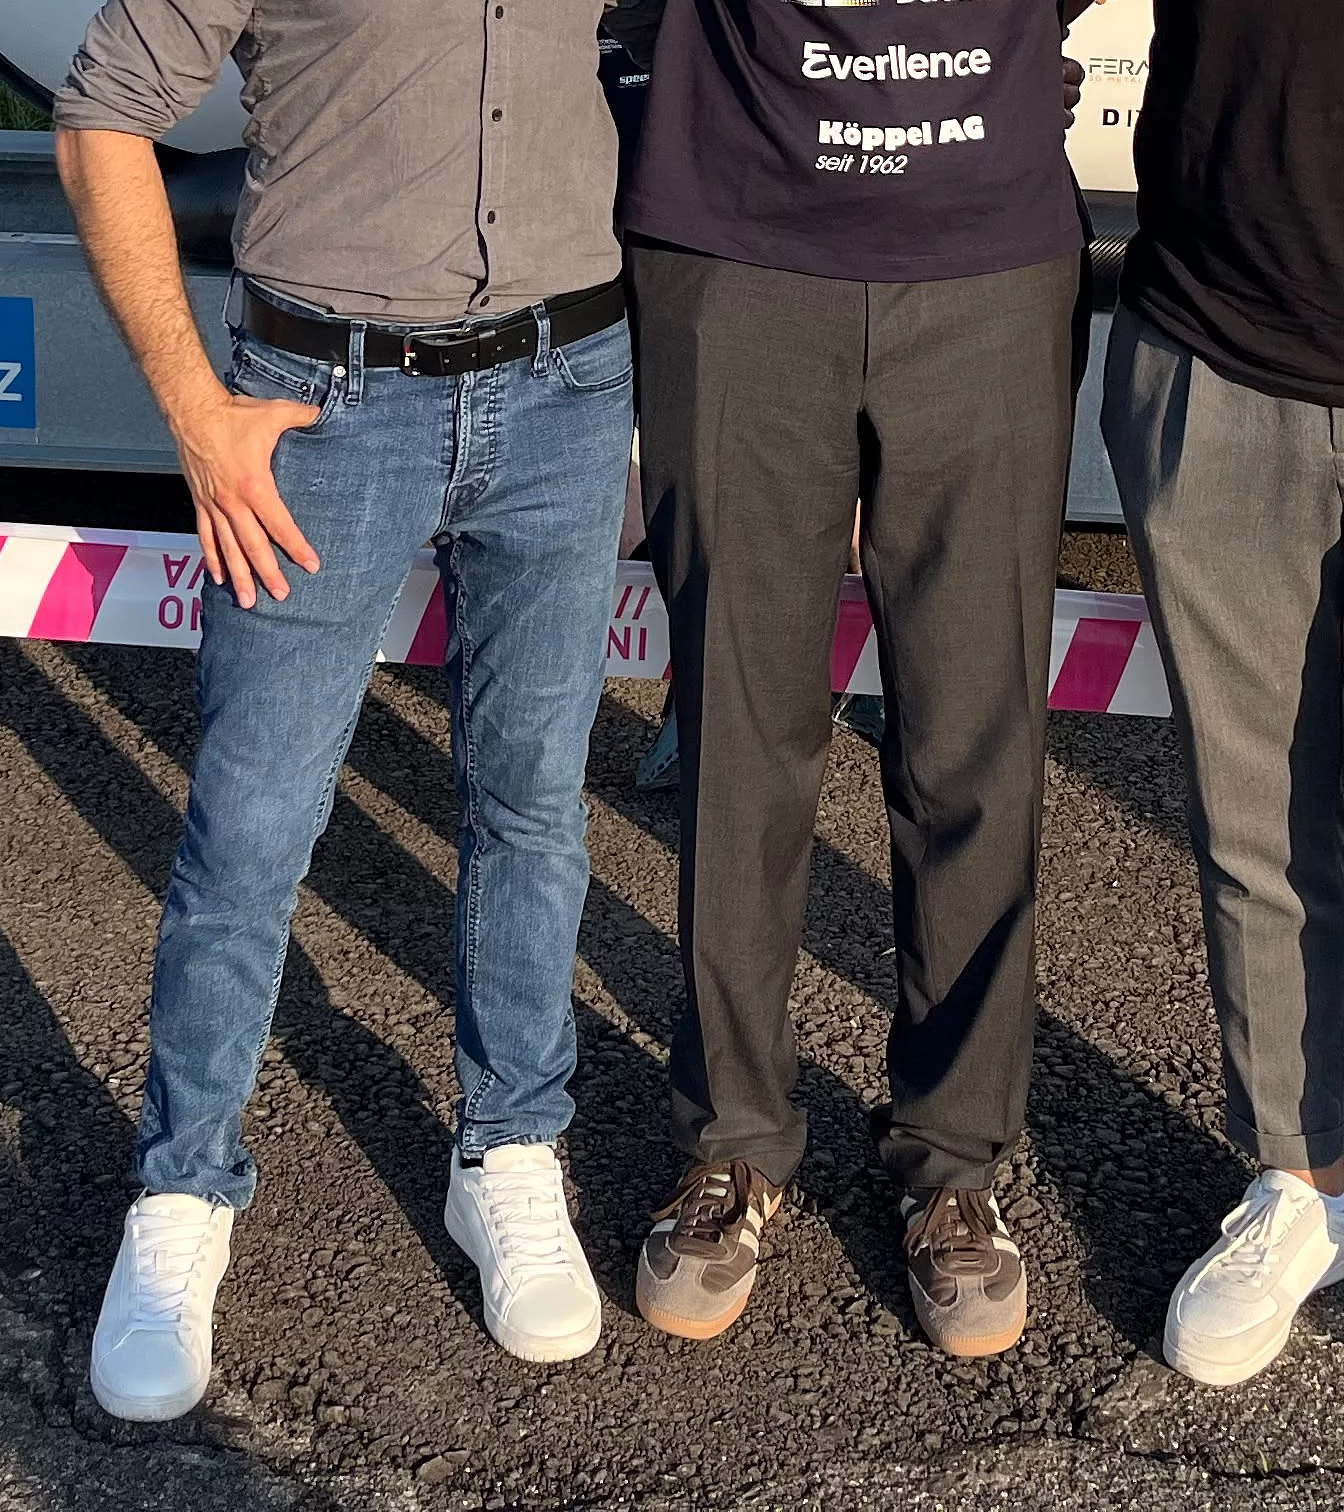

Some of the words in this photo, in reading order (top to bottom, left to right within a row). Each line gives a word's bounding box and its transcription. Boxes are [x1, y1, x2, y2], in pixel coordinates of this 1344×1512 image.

[801, 42, 992, 81] Everllence
[818, 119, 933, 151] Köppel
[938, 115, 985, 144] AG
[815, 153, 855, 172] seit
[859, 155, 908, 174] 1962
